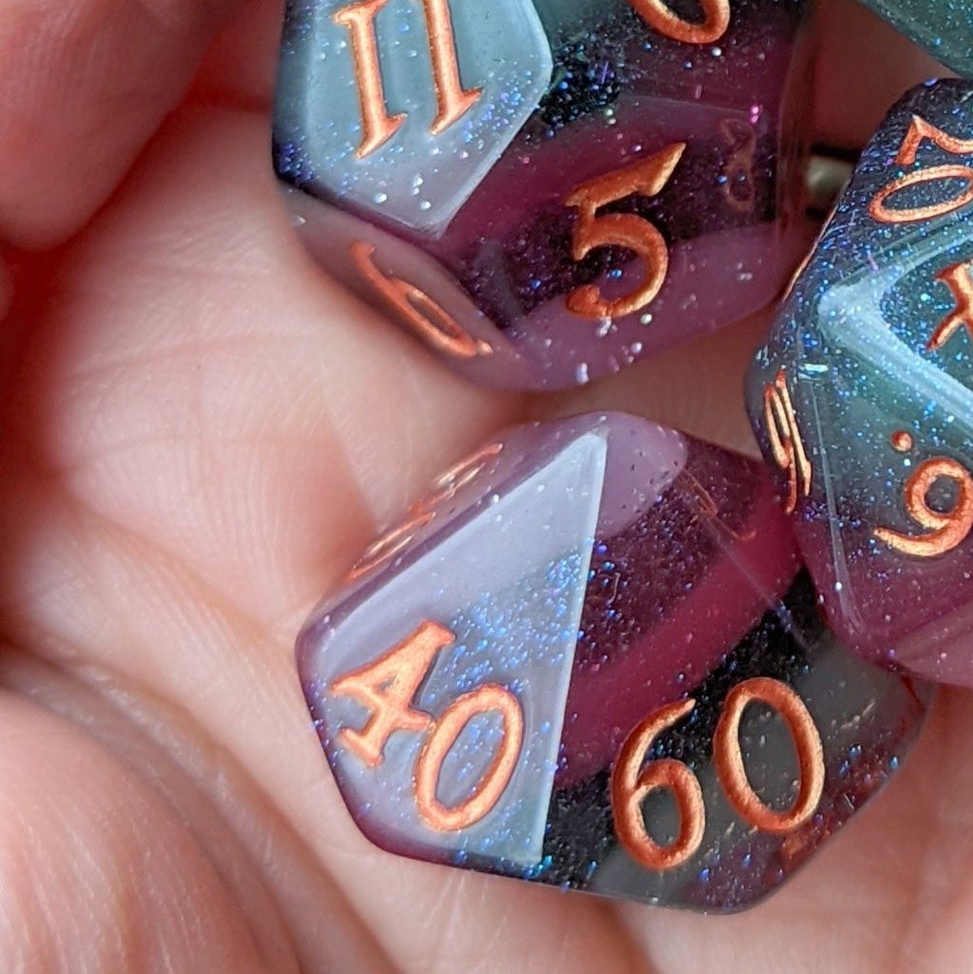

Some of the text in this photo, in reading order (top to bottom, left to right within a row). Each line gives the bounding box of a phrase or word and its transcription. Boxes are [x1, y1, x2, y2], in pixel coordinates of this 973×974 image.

[563, 140, 688, 319] 5
[329, 619, 525, 833] 40
[610, 676, 826, 871] 60
